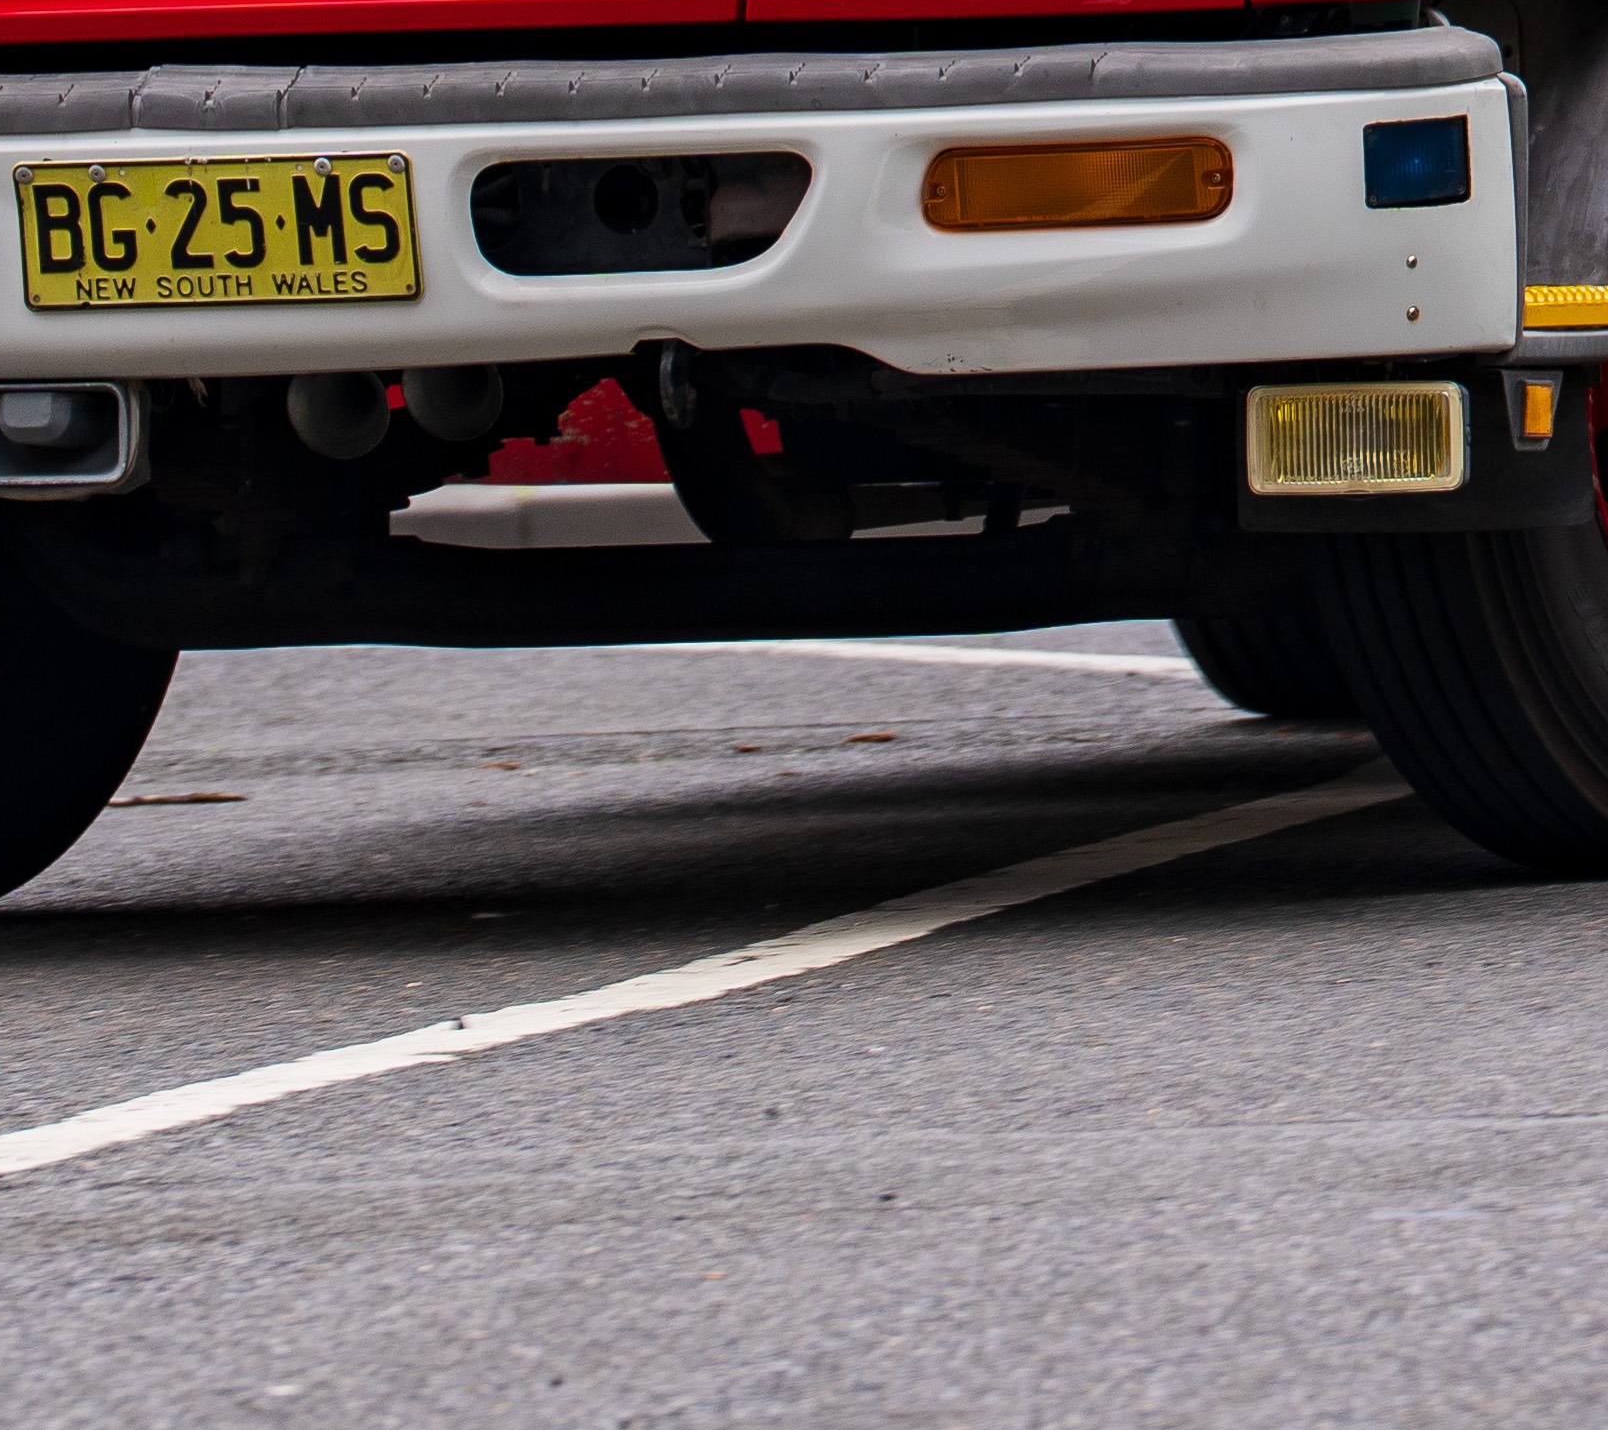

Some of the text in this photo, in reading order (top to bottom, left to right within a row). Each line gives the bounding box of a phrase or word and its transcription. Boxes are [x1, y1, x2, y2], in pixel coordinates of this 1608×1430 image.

[76, 270, 368, 301] NEW SOUTH WALES
